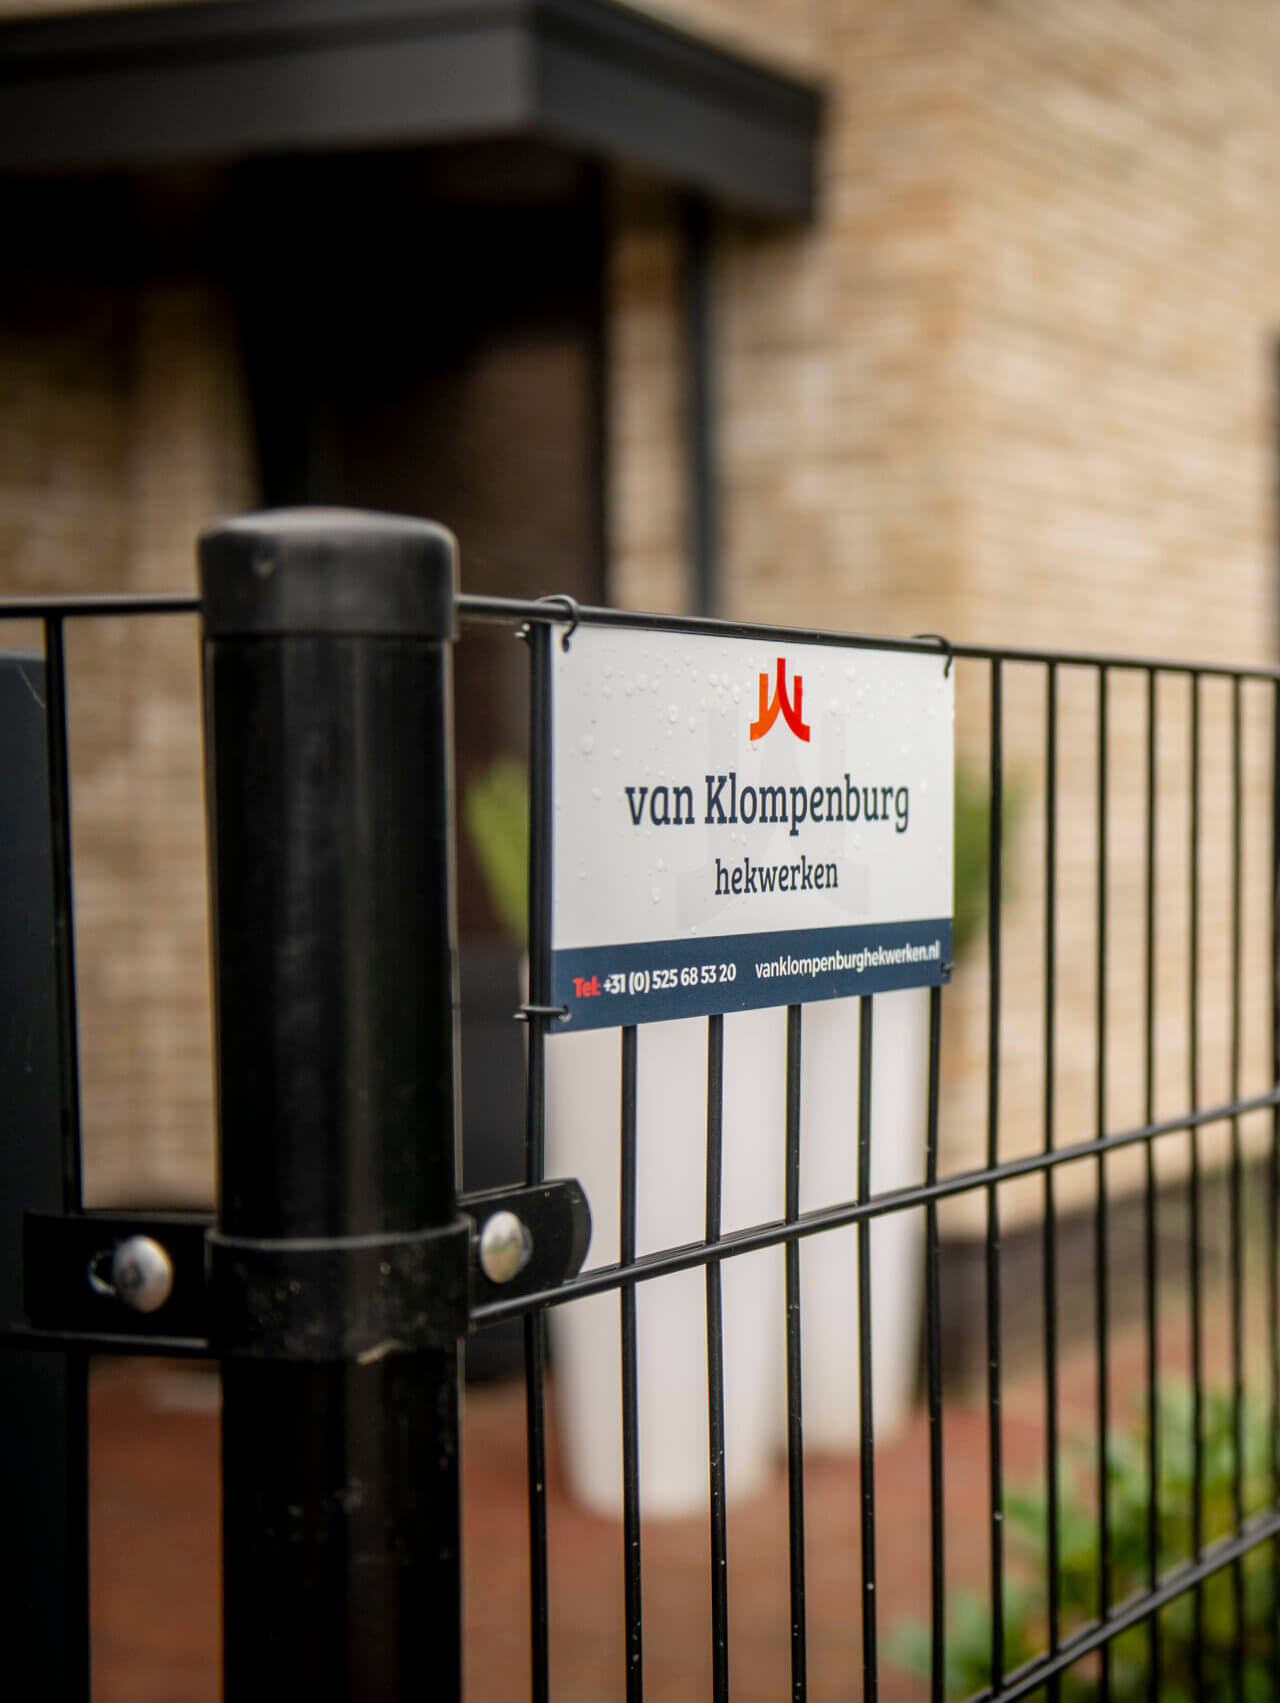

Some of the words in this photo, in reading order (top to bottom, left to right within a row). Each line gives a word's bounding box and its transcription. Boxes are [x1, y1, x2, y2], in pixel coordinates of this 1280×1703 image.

[625, 785, 695, 826] van
[704, 772, 909, 836] Klompenburg
[714, 855, 839, 895] hekwerken
[603, 973, 626, 995] +31
[628, 970, 651, 995] (0)
[652, 968, 678, 989] 525
[680, 966, 699, 987] 68
[700, 964, 717, 984] 53
[719, 962, 737, 982] 20
[755, 940, 941, 979] vanklompenburghekwerken.nl
